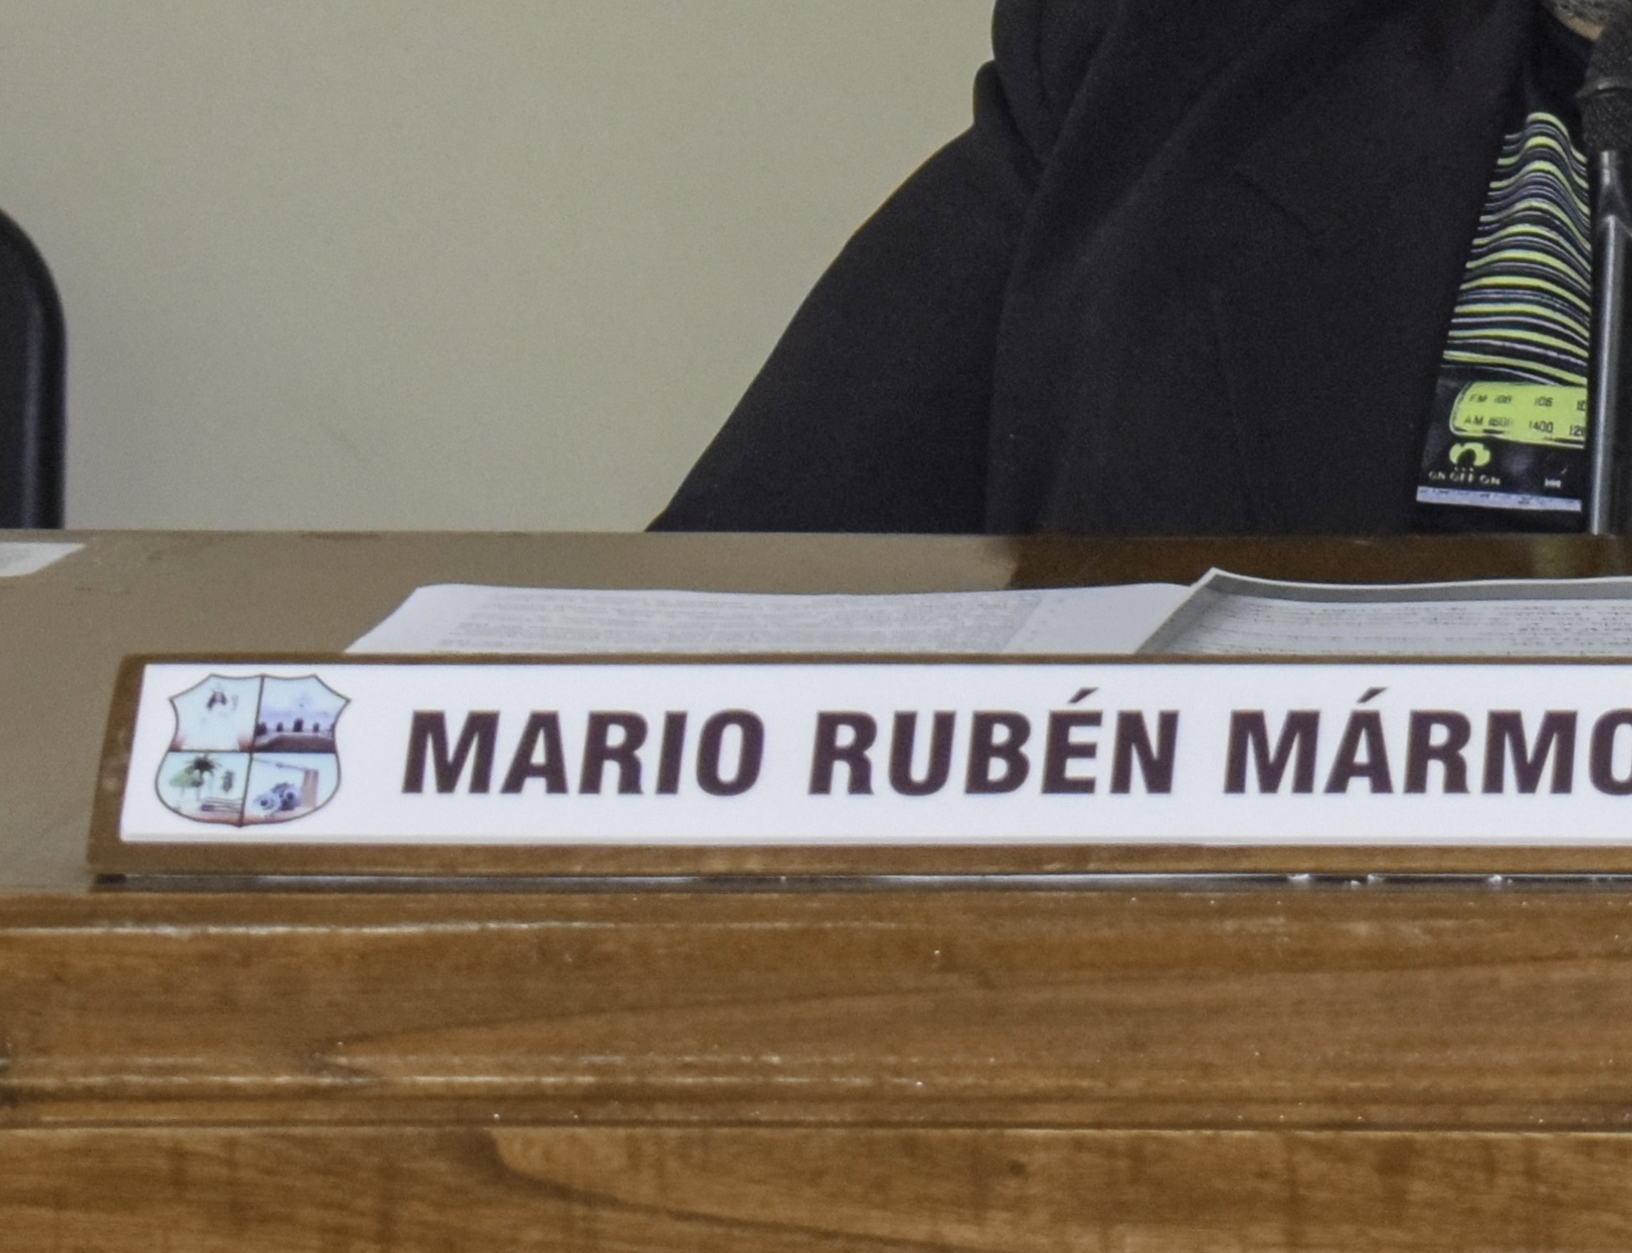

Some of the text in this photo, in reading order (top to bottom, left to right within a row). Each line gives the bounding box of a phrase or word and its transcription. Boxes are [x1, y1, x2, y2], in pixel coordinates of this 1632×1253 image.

[1464, 414, 1484, 425] AM
[1528, 419, 1554, 434] 1400
[404, 711, 763, 796] MARIO
[810, 690, 1178, 795] RUBÉN
